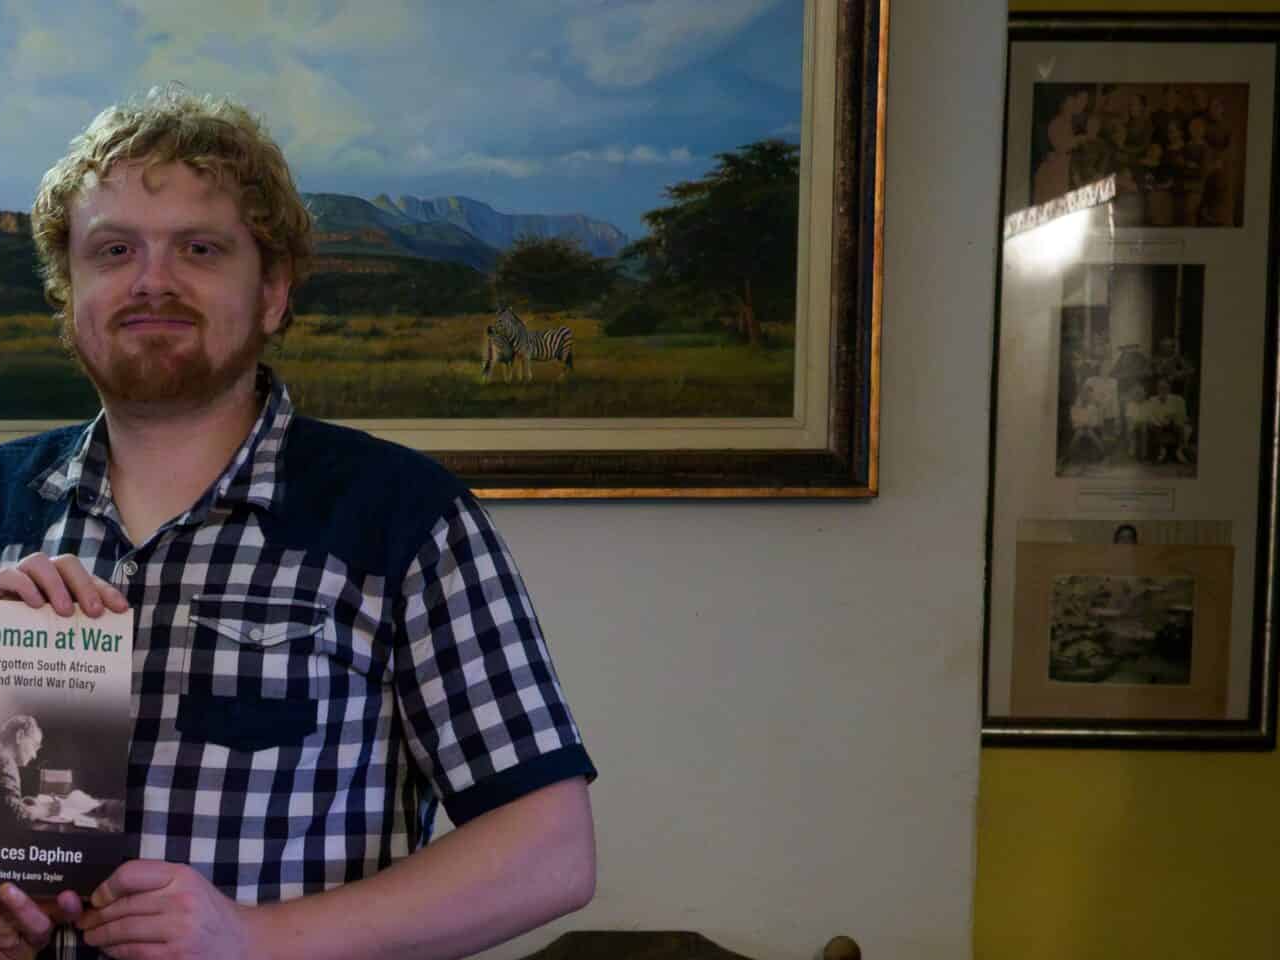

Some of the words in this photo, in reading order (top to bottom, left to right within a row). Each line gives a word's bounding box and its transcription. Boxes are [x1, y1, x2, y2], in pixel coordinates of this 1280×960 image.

[55, 628, 76, 650] at
[81, 627, 123, 653] War
[37, 660, 66, 673] South
[70, 662, 106, 674] African
[14, 675, 43, 688] World
[46, 677, 66, 688] War
[68, 678, 96, 694] Diary
[29, 845, 83, 865] Daphne
[12, 870, 21, 881] by
